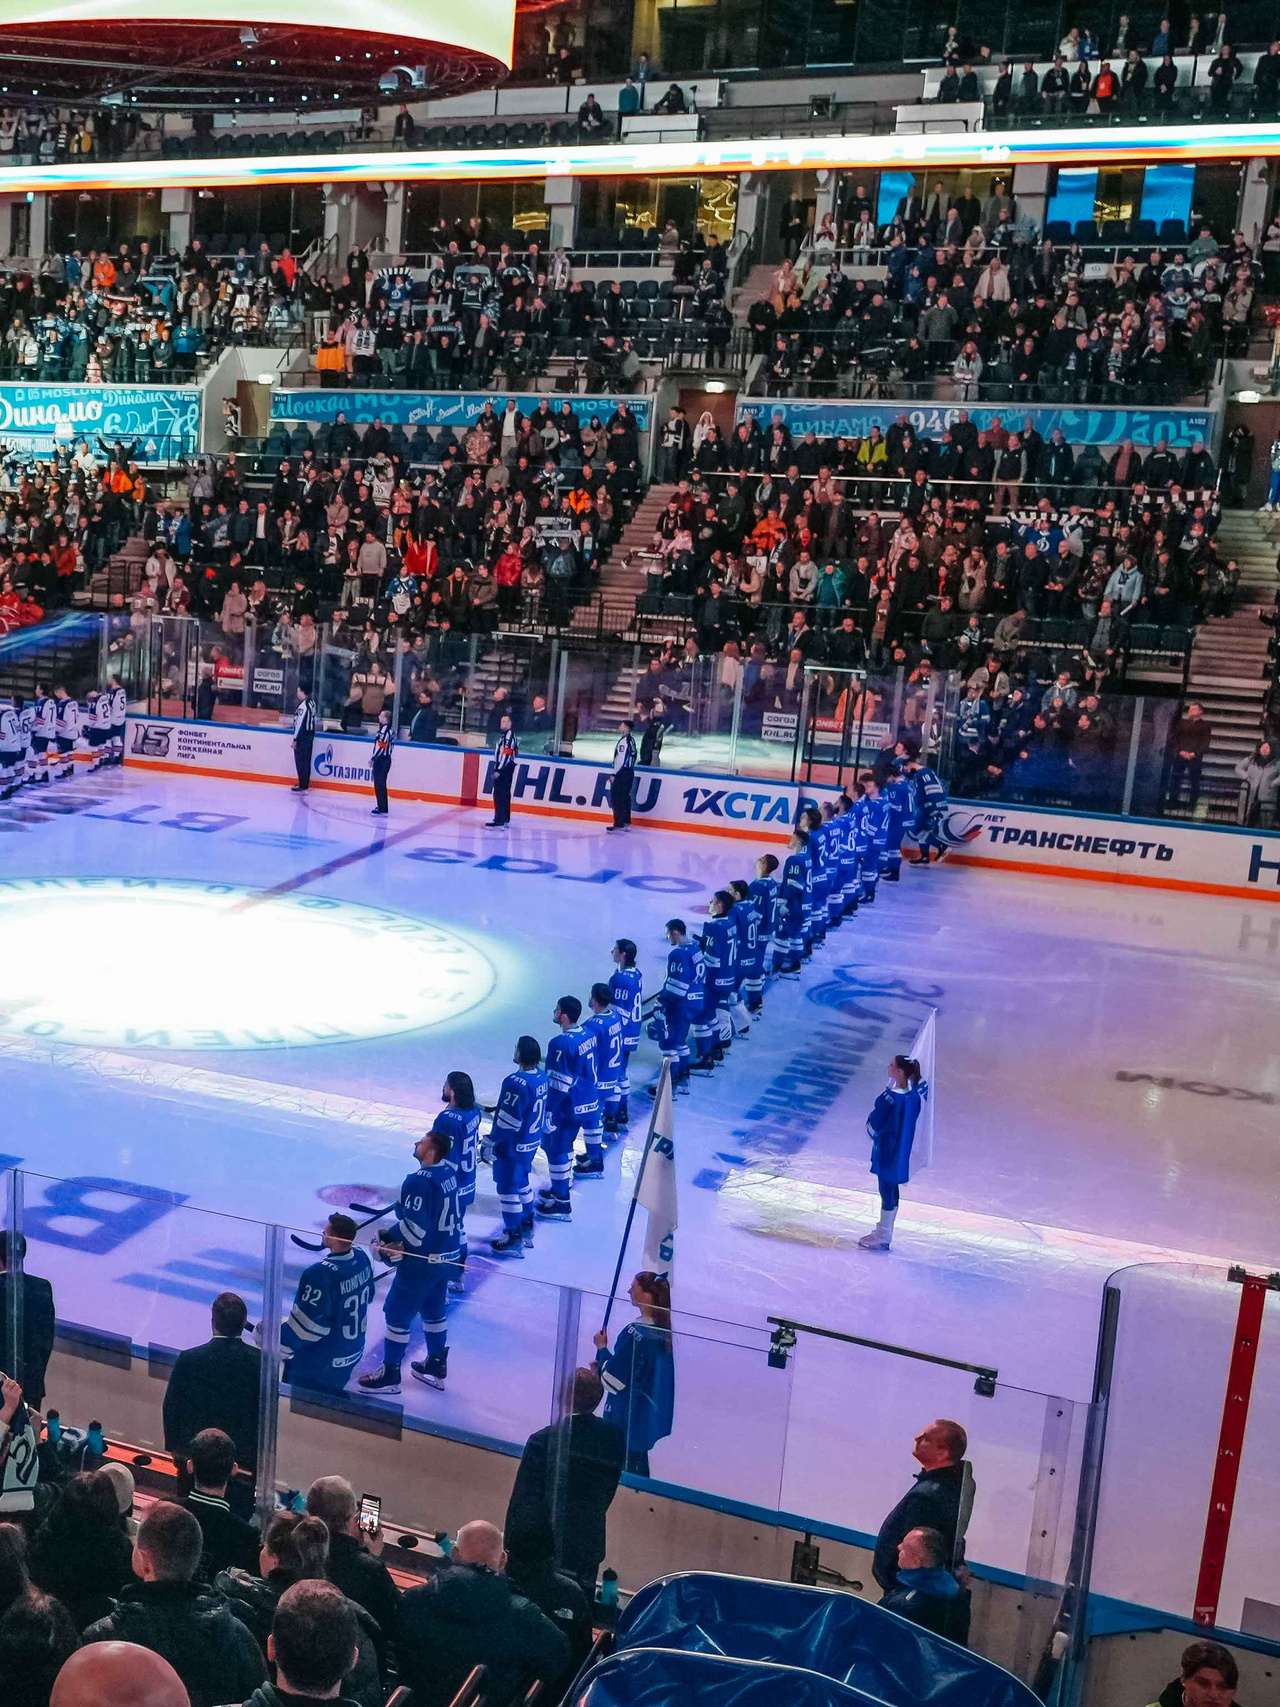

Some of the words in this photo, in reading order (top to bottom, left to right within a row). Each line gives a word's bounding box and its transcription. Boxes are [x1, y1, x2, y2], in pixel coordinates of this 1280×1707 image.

[103, 391, 166, 407] Динамо
[896, 410, 960, 433] 946
[177, 729, 208, 738] ФОНБЕТ
[177, 737, 252, 751] КОНТИНЕНТАЛЬНАЯ
[177, 744, 223, 755] ХОККЕЙНАЯ
[177, 752, 196, 760] ЛИГА
[333, 766, 376, 781] ГАЗПРО
[988, 826, 1174, 862] ТРАНСНЕФТЬ
[503, 1092, 519, 1107] 27
[404, 1194, 423, 1212] 49
[301, 1284, 322, 1306] 32
[342, 1285, 370, 1341] 32
